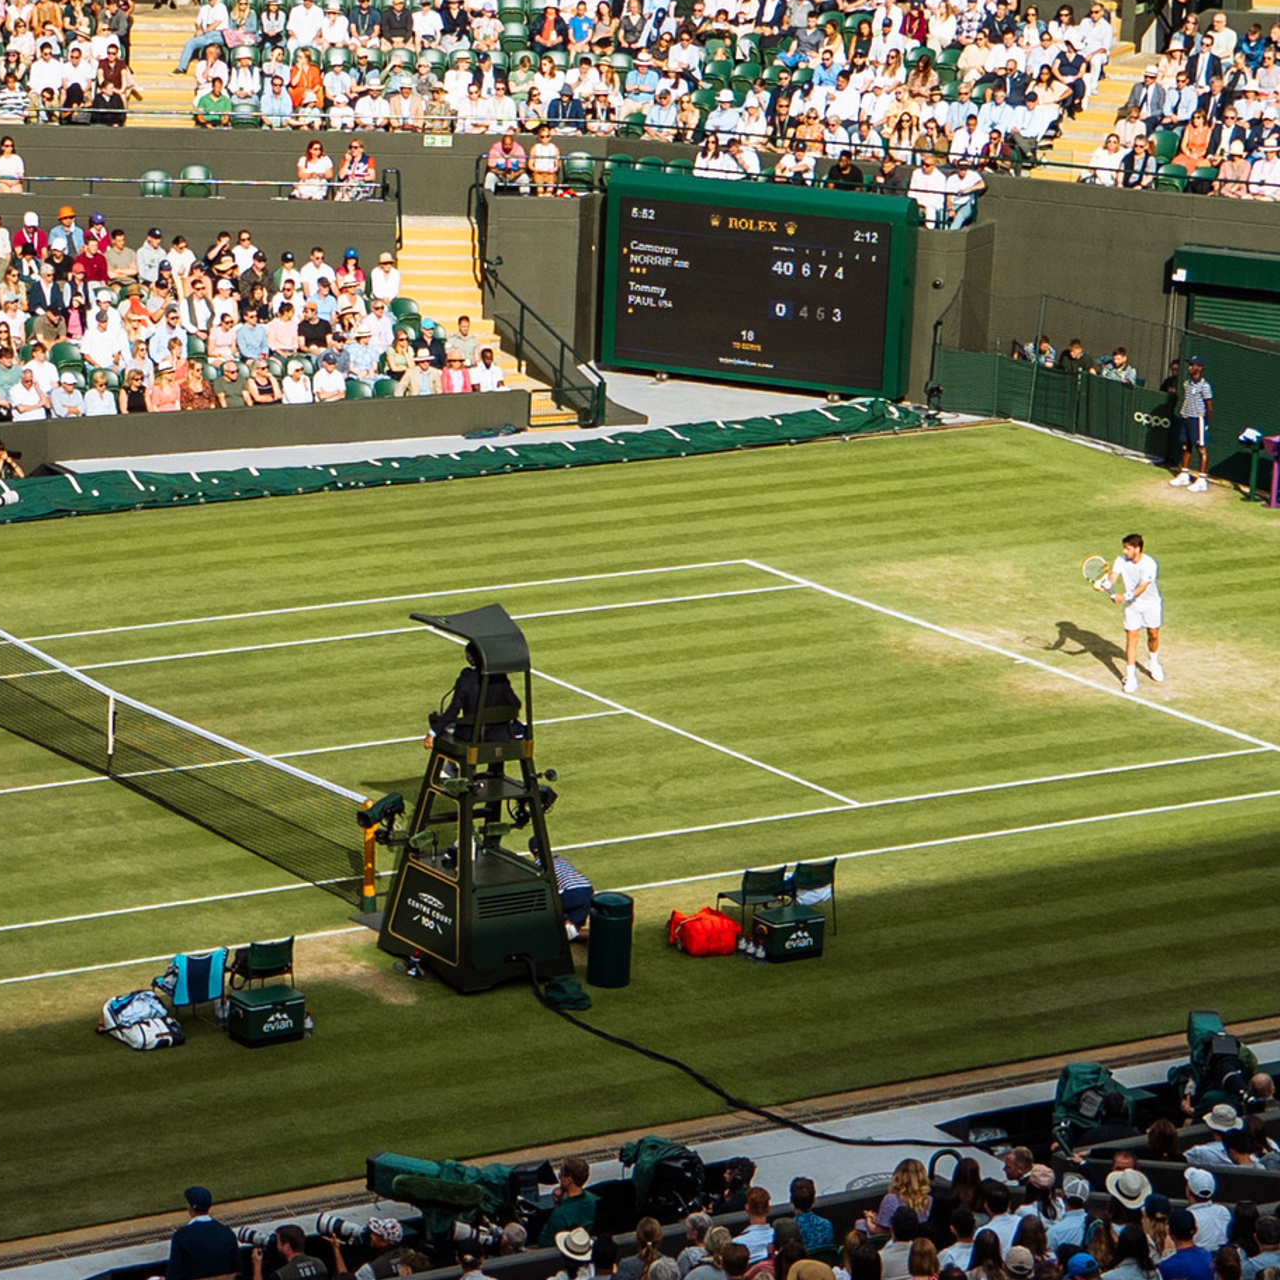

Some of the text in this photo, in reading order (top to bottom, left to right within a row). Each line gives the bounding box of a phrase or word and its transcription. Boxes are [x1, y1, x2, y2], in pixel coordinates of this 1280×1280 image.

[728, 217, 777, 233] ROLEX
[853, 230, 879, 244] 2:12
[630, 240, 679, 256] Cameron
[629, 254, 673, 267] NORRIE
[771, 261, 844, 280] 40 6 7 4
[628, 281, 667, 298] Tommy
[627, 295, 657, 308] PAUL
[775, 303, 786, 317] 0
[799, 305, 809, 318] 4
[832, 308, 842, 323] 3
[1134, 411, 1170, 428] oppo
[421, 915, 435, 930] 100
[785, 937, 813, 950] evian
[262, 1019, 294, 1033] evian
